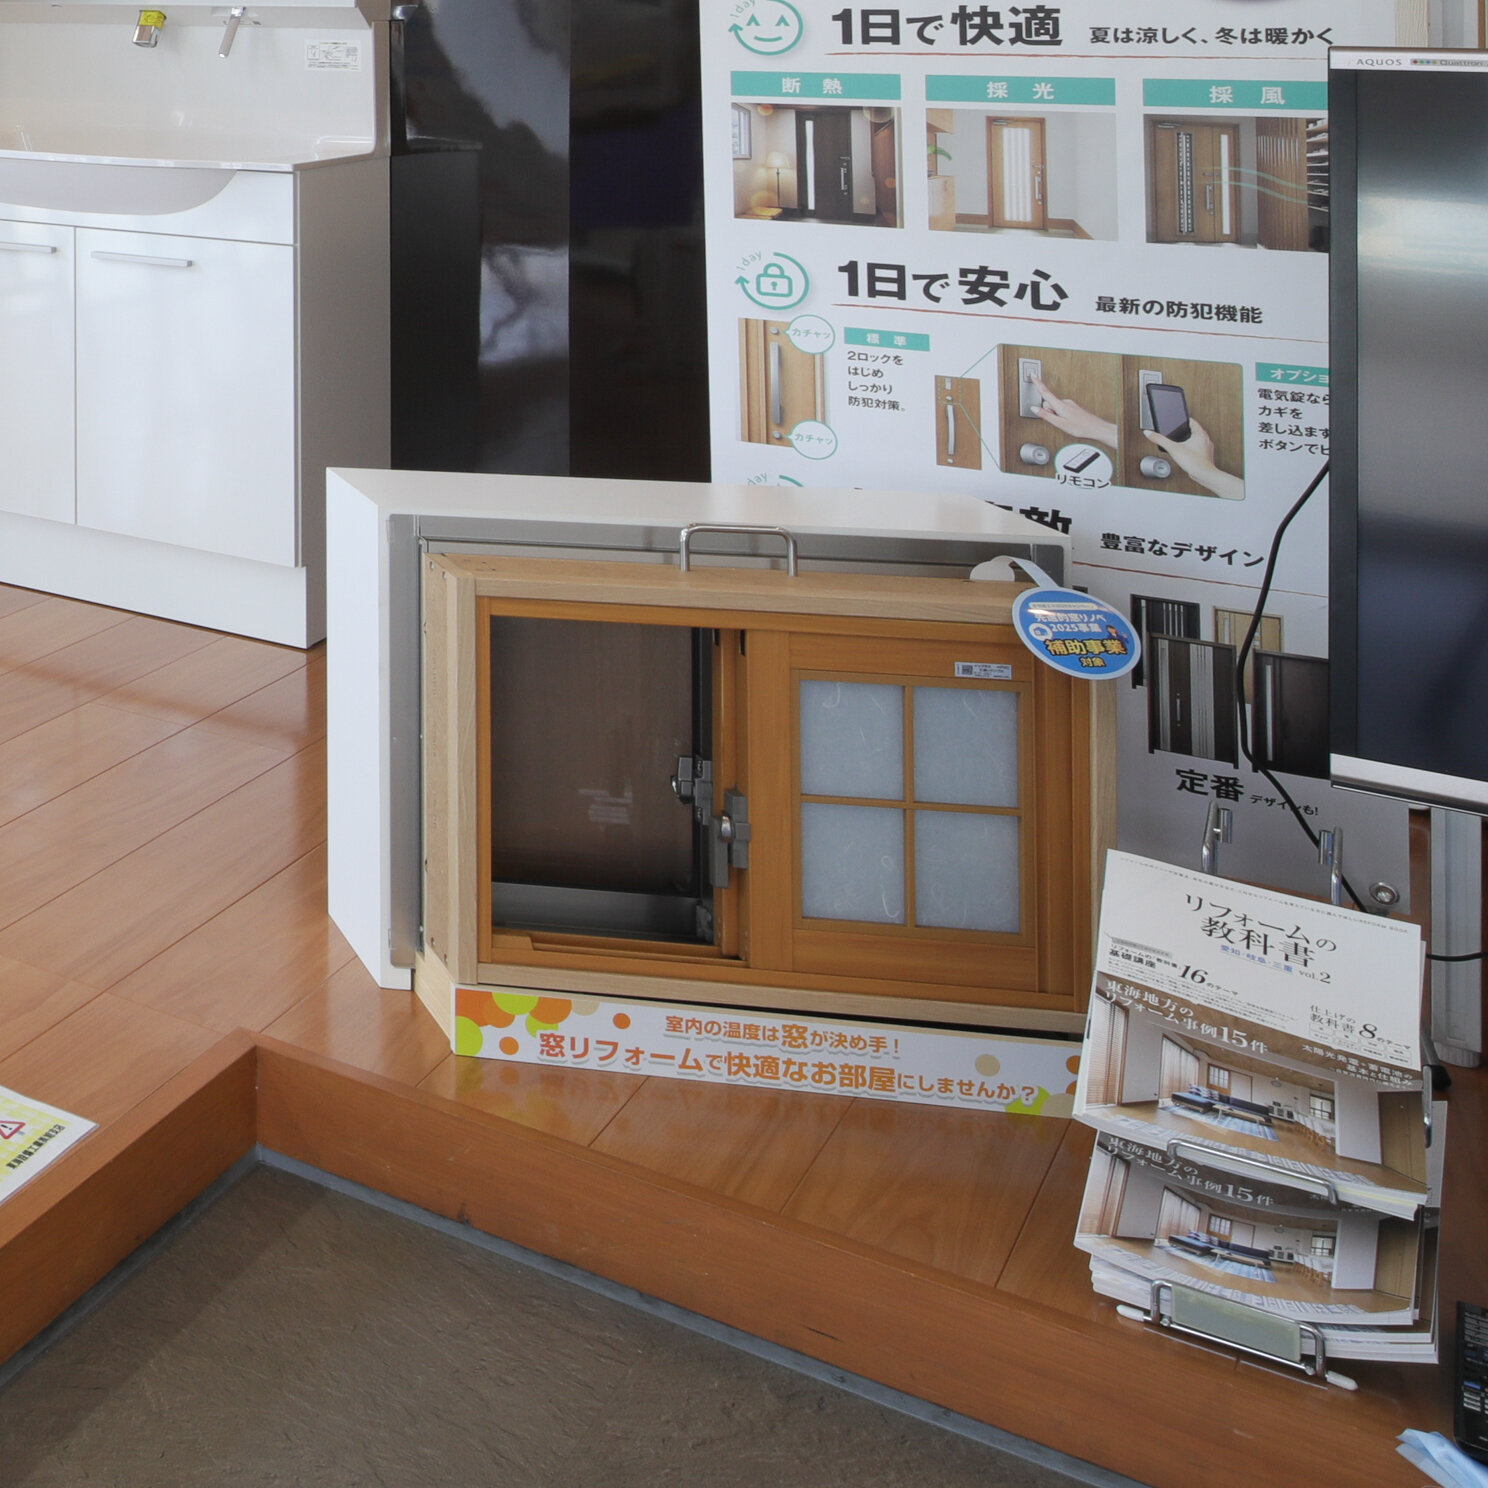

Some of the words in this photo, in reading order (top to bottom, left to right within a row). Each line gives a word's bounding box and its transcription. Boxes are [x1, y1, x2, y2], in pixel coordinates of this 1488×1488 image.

[831, 4, 1063, 47] 1日で快適
[1089, 26, 1334, 46] 夏は涼しく、冬は暖かく
[1356, 58, 1403, 66] AQUOS
[781, 76, 844, 96] 断熱
[986, 80, 1055, 101] 採光
[1209, 85, 1286, 106] 採風
[838, 258, 1069, 312] 1日で安心
[1095, 295, 1264, 324] 最新の防犯機能
[791, 326, 832, 341] カチャッ
[865, 331, 908, 348] 標準
[847, 350, 904, 366] 2ロックを
[847, 365, 884, 380] はじめ
[847, 380, 894, 395] しっかり
[1258, 388, 1330, 406] 電気錠なら
[847, 395, 906, 412] 防犯対策。
[1258, 405, 1303, 420] カギを
[793, 431, 835, 446] カチャッ
[1056, 472, 1112, 489] リモコン
[1100, 532, 1265, 568] 豊富なデザイン
[1045, 639, 1126, 655] 補助事業
[1081, 656, 1105, 667] 対象
[1175, 768, 1244, 802] 定番
[1186, 893, 1337, 953] リフォームの
[1201, 917, 1315, 968] 教科書
[1299, 970, 1331, 984] vol.2
[1106, 980, 1193, 1017] 東海地方の
[1105, 990, 1269, 1054] リフォーム事例15件
[666, 1014, 901, 1057] 室内の温度は窓が決め手！
[539, 1031, 1037, 1104] 窓リフォームで快適なお部屋にしませんか？
[1108, 1136, 1200, 1175] 東海地方の
